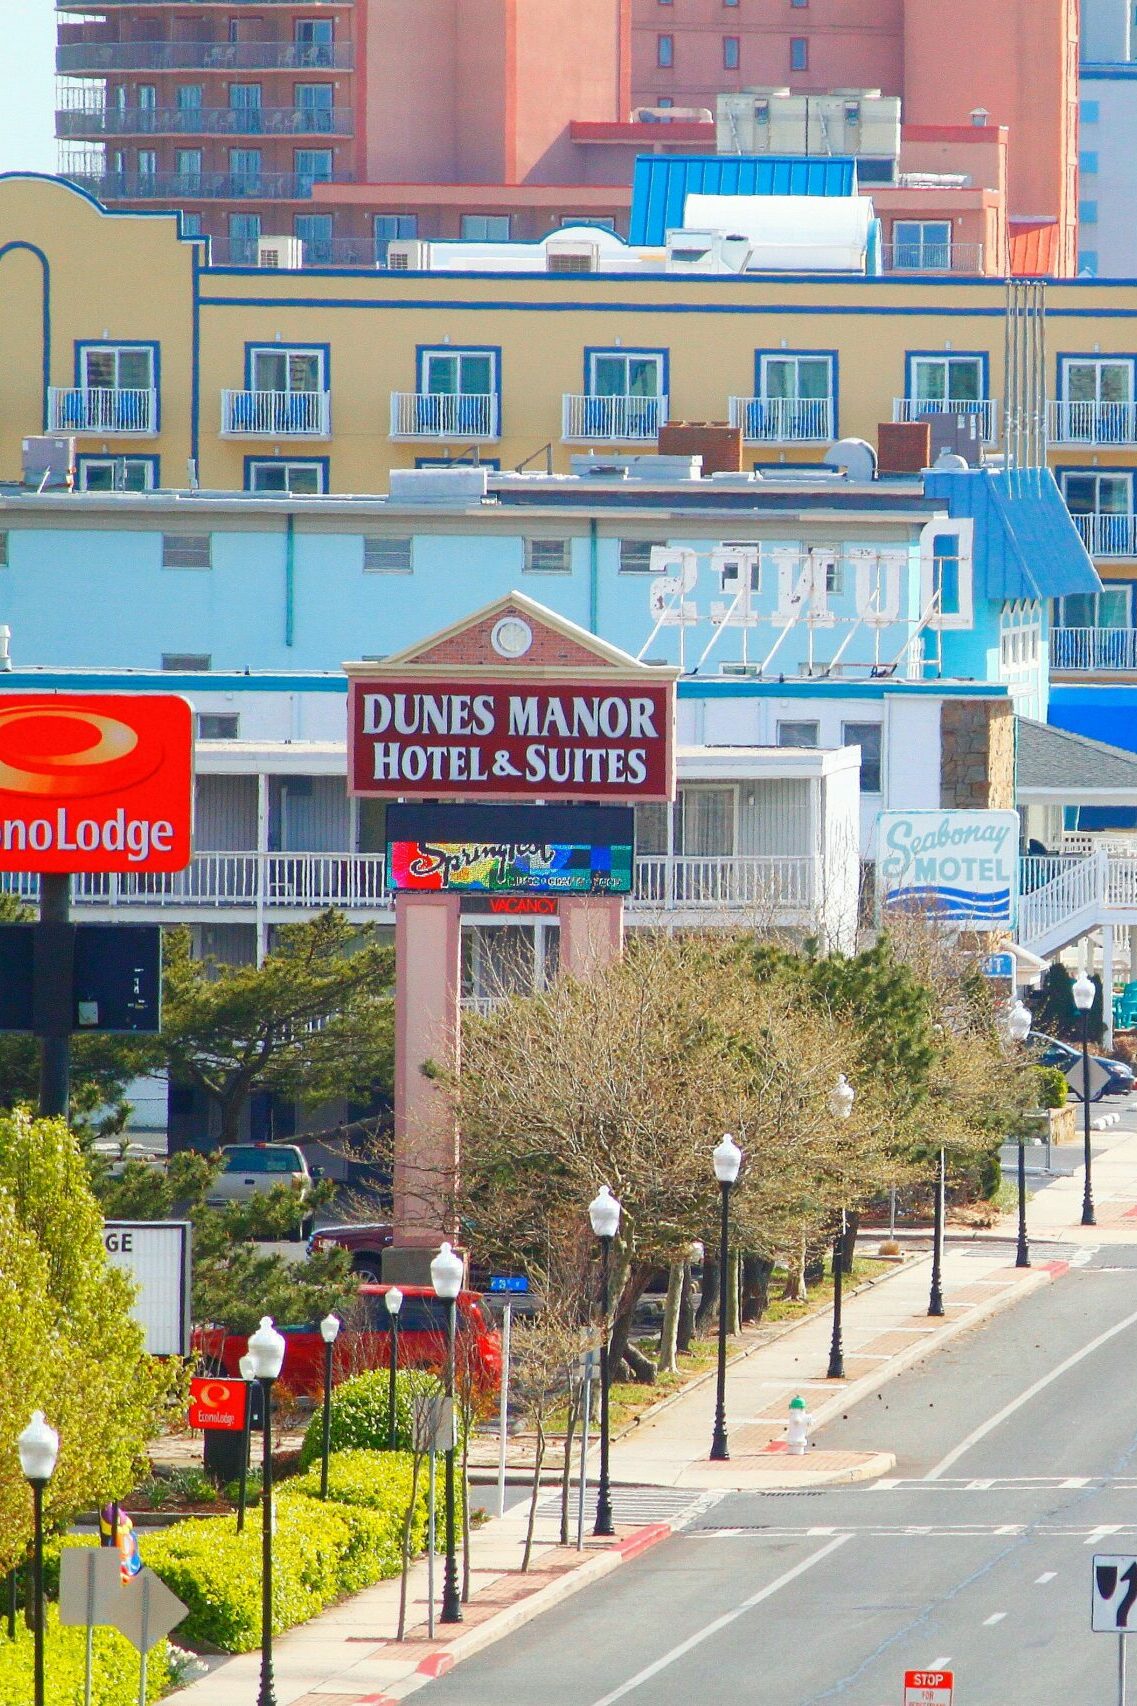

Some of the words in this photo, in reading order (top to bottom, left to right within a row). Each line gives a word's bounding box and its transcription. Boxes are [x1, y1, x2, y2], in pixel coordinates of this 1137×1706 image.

[362, 693, 495, 735] DUNES
[508, 696, 659, 738] MANOR
[373, 742, 488, 781] HOTEL
[492, 750, 523, 776] &
[525, 744, 647, 784] SUITES
[882, 819, 1011, 878] Seabonay
[914, 857, 1010, 882] MOTEL
[489, 898, 557, 913] VACANCY
[105, 1233, 133, 1252] GE
[914, 1673, 944, 1686] STOP
